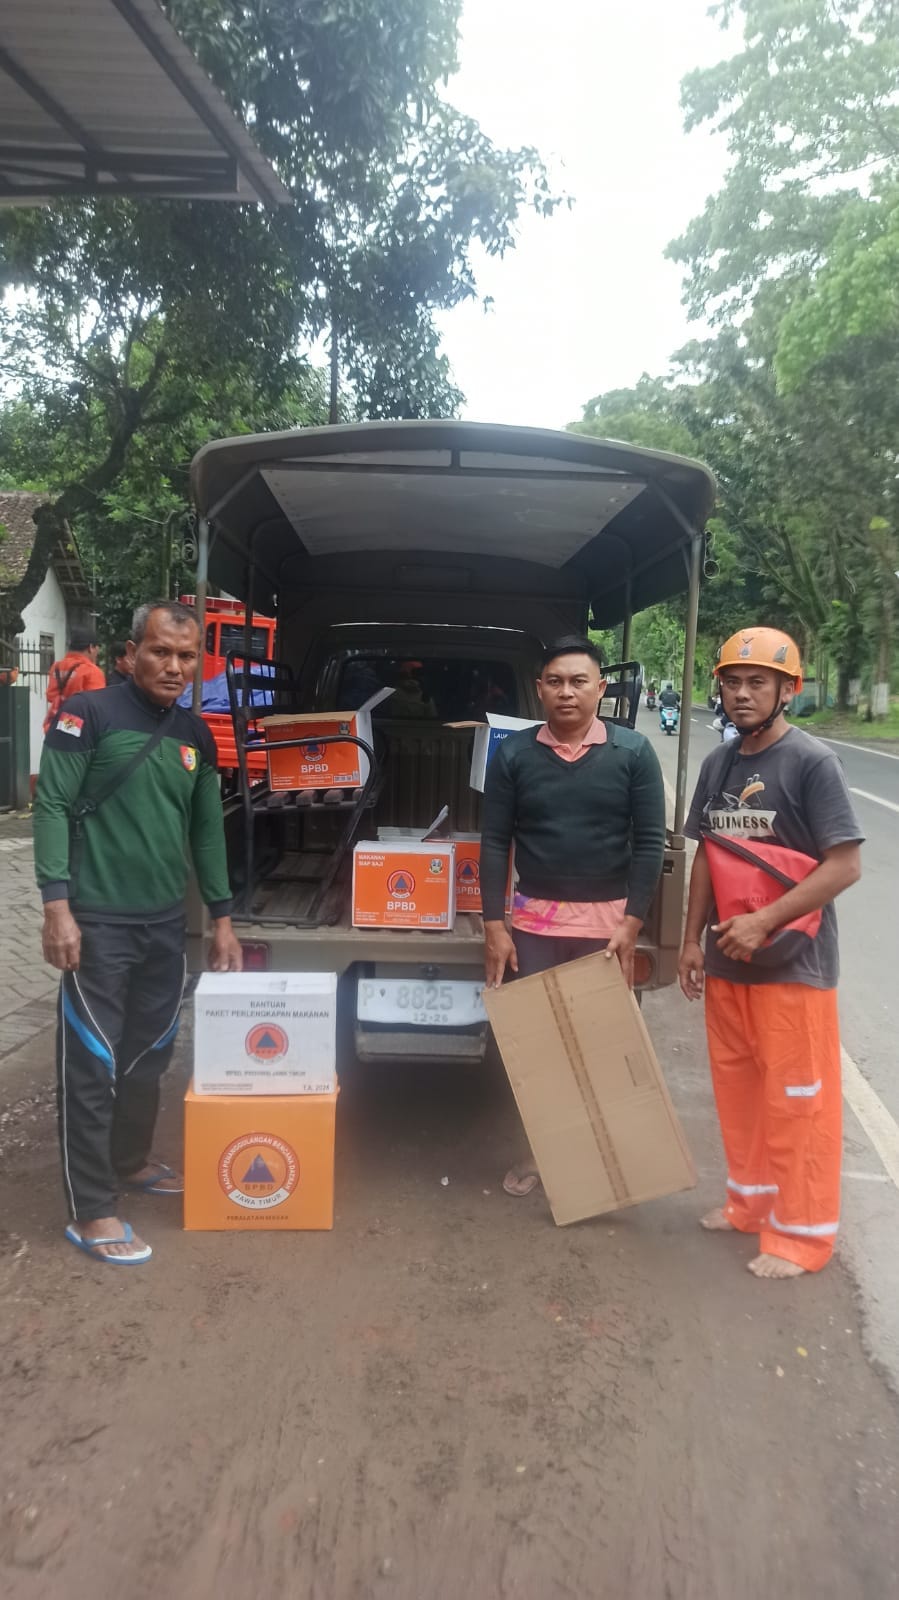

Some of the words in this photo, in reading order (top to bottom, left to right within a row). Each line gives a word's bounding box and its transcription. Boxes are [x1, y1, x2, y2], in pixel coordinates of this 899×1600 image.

[301, 764, 329, 774] BPBD
[455, 886, 481, 896] BPBD
[386, 901, 416, 911] BPBD
[362, 983, 375, 1007] P
[397, 985, 453, 1010] 8825
[250, 1000, 286, 1009] BANTUAN
[231, 1010, 291, 1018] PERLENGKAPAN
[292, 1010, 330, 1018] MAKANAN
[235, 1194, 256, 1205] JAWA
[258, 1193, 281, 1206] TIMUR
